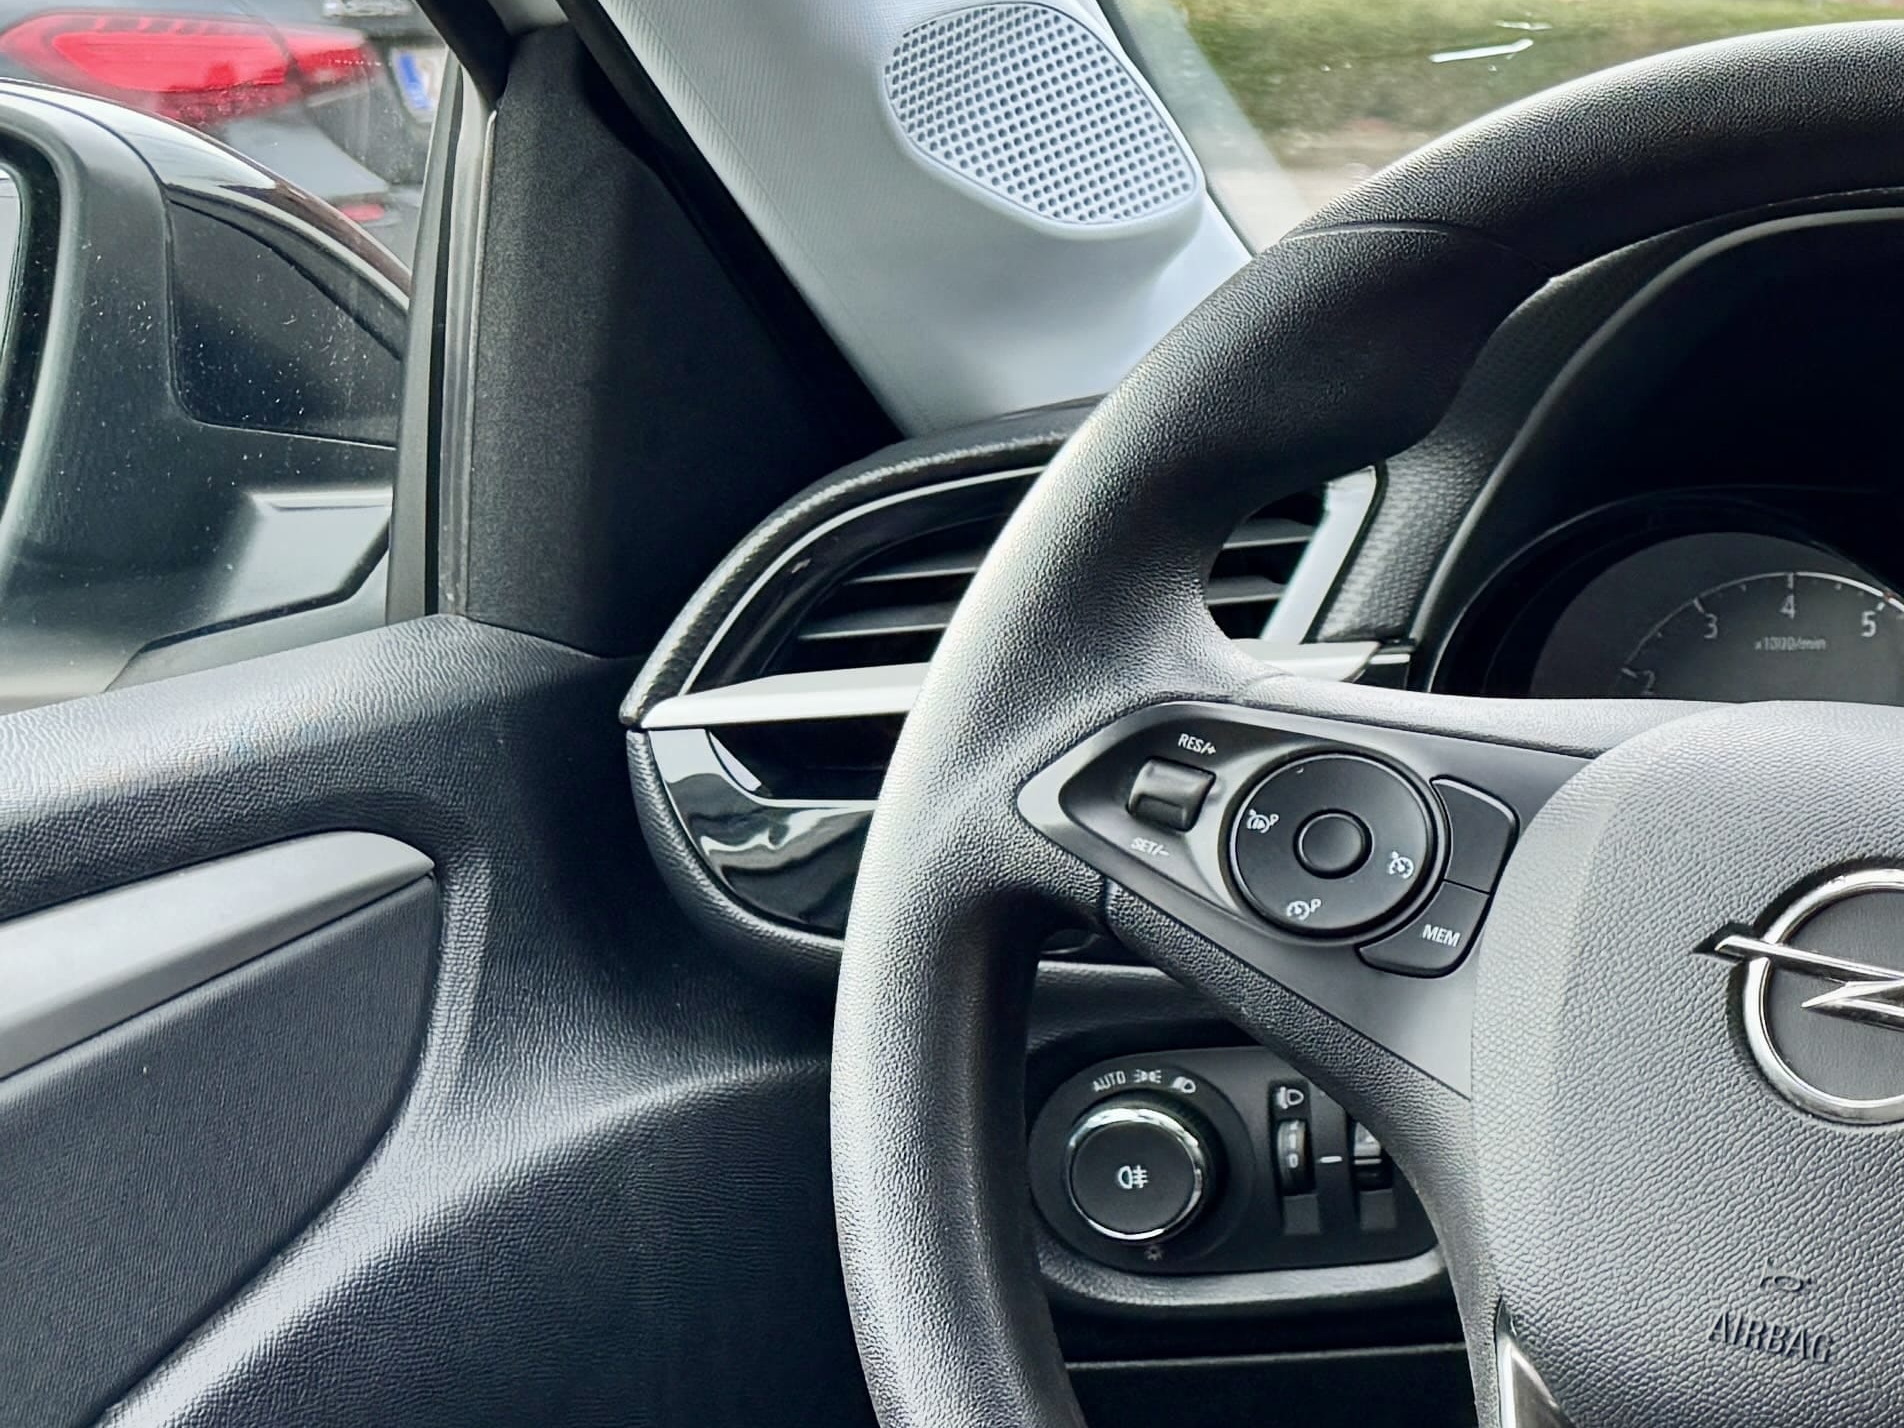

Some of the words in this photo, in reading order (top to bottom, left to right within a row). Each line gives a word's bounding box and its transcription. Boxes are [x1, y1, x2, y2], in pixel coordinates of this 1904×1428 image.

[1780, 594, 1796, 619] 4
[1703, 613, 1719, 639] 3
[1861, 610, 1877, 638] 5
[1421, 923, 1461, 948] MEM
[1093, 1070, 1127, 1093] AUTO
[1707, 1310, 1834, 1364] AIRBAG
